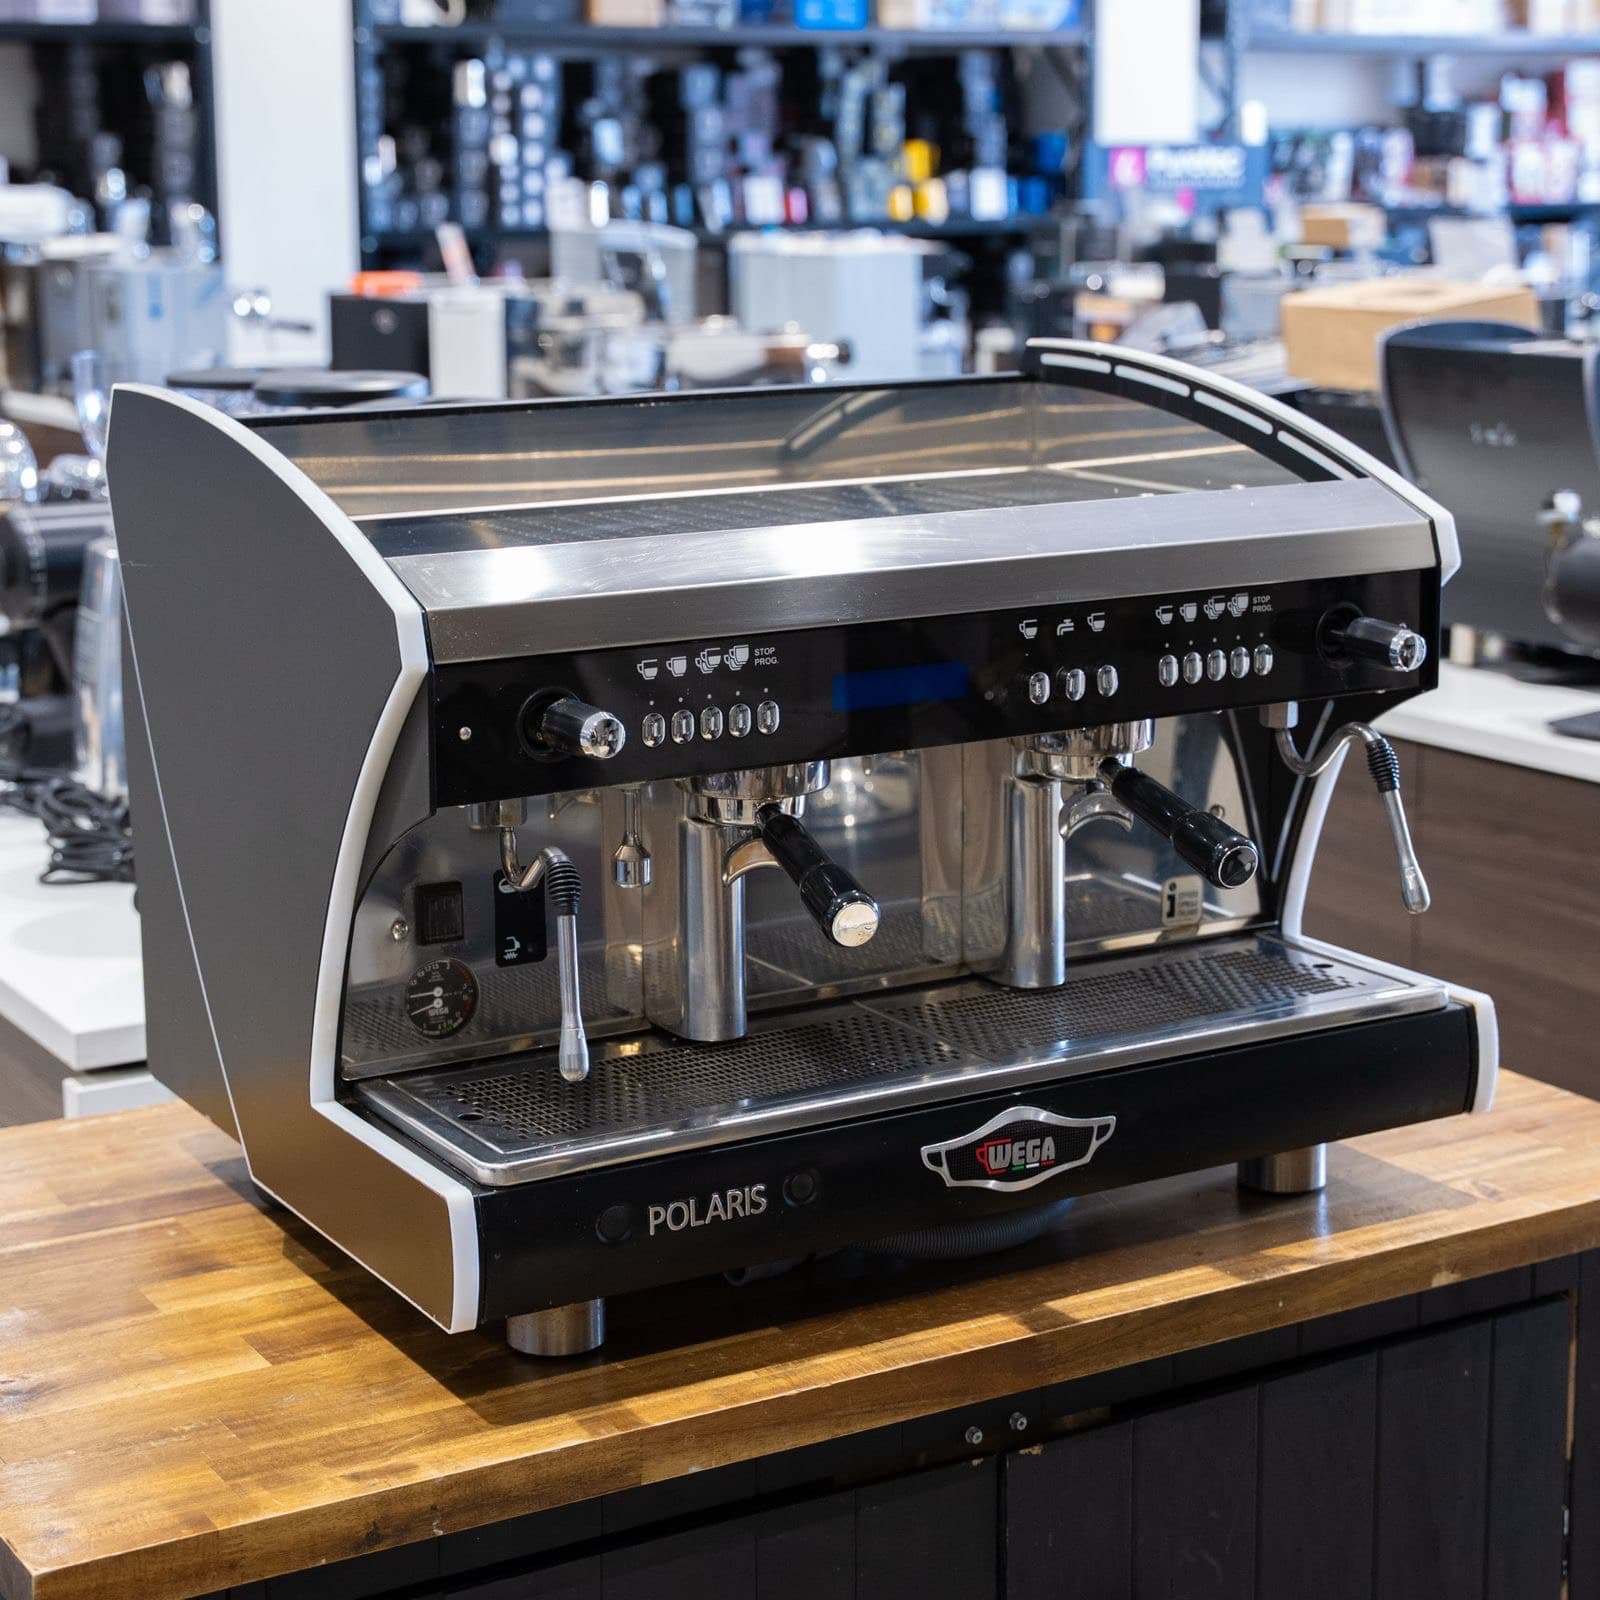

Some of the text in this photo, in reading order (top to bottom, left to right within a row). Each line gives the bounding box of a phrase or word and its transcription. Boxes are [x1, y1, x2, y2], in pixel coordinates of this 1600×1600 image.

[1252, 595, 1271, 604] STOP
[754, 647, 775, 657] STOP
[754, 656, 780, 666] PROG.
[988, 1136, 1056, 1170] WEGA
[648, 1183, 767, 1236] POLARIS
